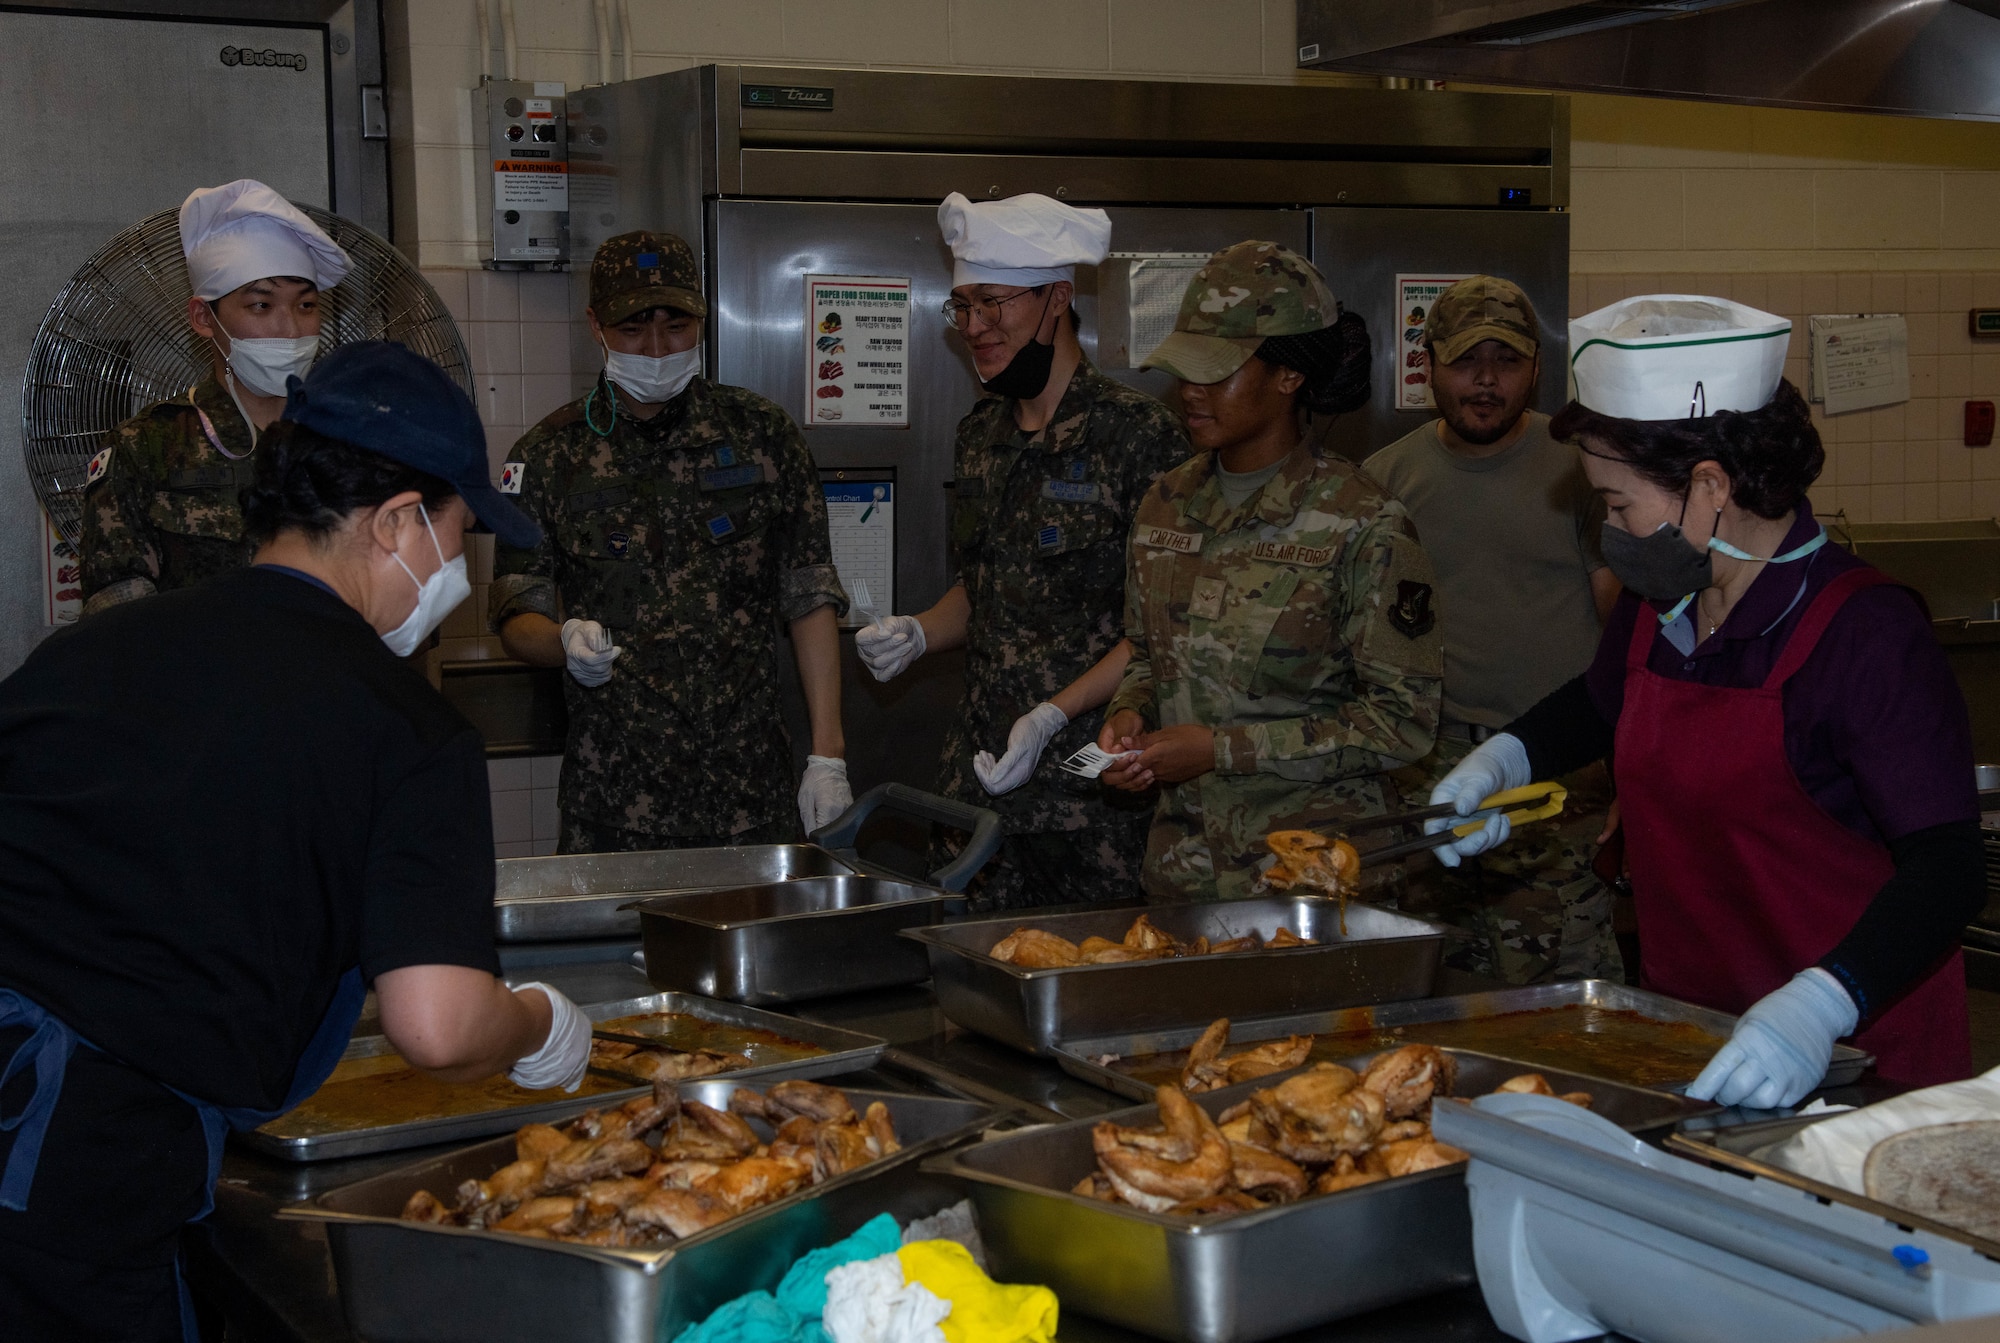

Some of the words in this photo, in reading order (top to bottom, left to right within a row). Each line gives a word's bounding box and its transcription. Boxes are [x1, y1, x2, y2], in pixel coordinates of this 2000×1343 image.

[241, 49, 306, 71] BuSung
[781, 88, 828, 102] True
[1508, 189, 1514, 199] 3
[816, 290, 840, 299] PROPER
[842, 291, 857, 299] FOOD
[859, 292, 886, 300] STORAGE
[888, 292, 907, 301] ORDER
[1149, 529, 1191, 550] CARTHEN
[1256, 542, 1276, 558] U.S.
[1277, 544, 1296, 561] AIR
[1297, 546, 1334, 564] FORCE
